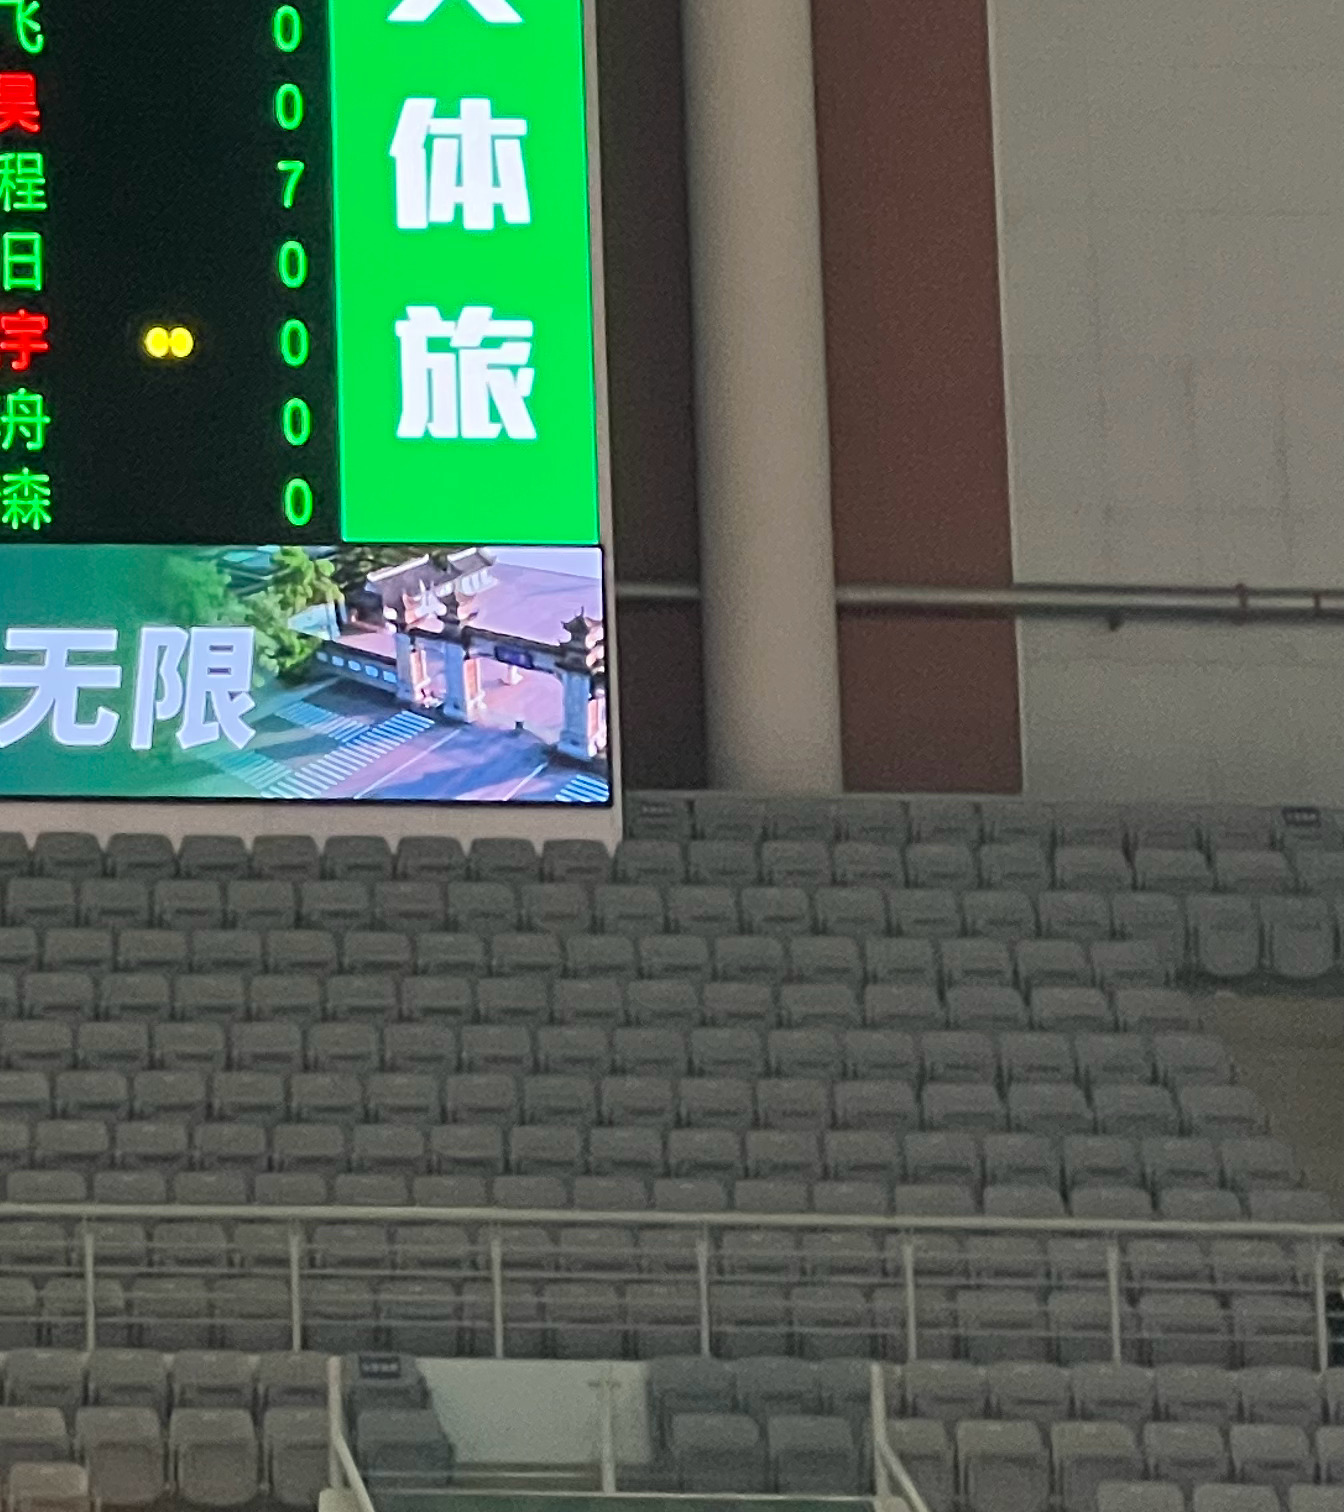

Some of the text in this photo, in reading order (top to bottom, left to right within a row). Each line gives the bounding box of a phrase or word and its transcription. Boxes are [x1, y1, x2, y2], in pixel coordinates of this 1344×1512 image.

[272, 5, 302, 52] 0
[275, 84, 303, 130] 0
[277, 160, 304, 208] 7
[279, 241, 307, 288] 0
[280, 319, 308, 366] 0
[282, 398, 310, 445] 0
[283, 478, 312, 525] 0
